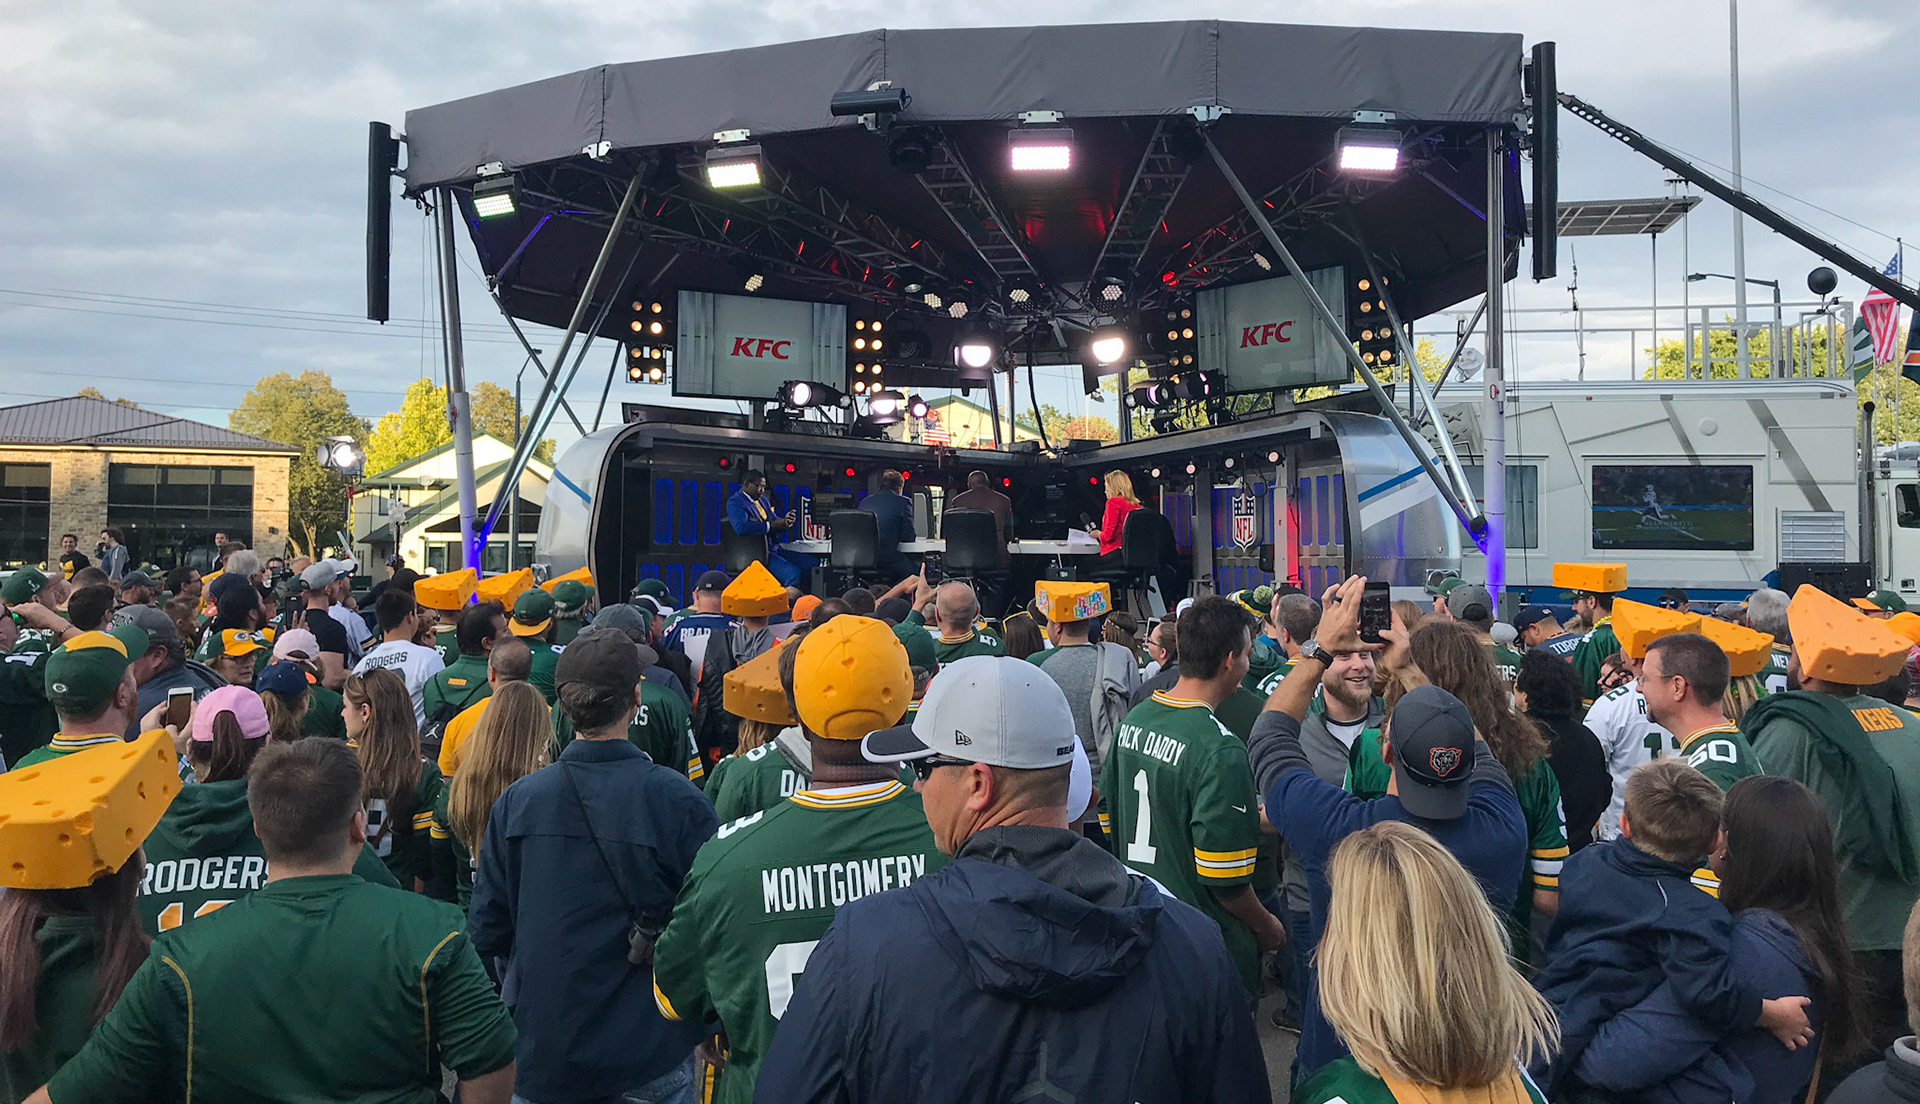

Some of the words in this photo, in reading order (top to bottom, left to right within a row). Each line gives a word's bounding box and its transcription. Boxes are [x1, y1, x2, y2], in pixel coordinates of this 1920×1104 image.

[730, 336, 791, 360] KFC
[1240, 320, 1293, 348] KFC
[1235, 517, 1253, 542] NFL
[365, 651, 408, 668] RODGERS
[1117, 723, 1143, 751] PACK
[1142, 731, 1186, 766] DADDY
[1127, 768, 1157, 865] 1
[136, 856, 269, 897] RODGER
[761, 853, 925, 913] MONTGOMERY
